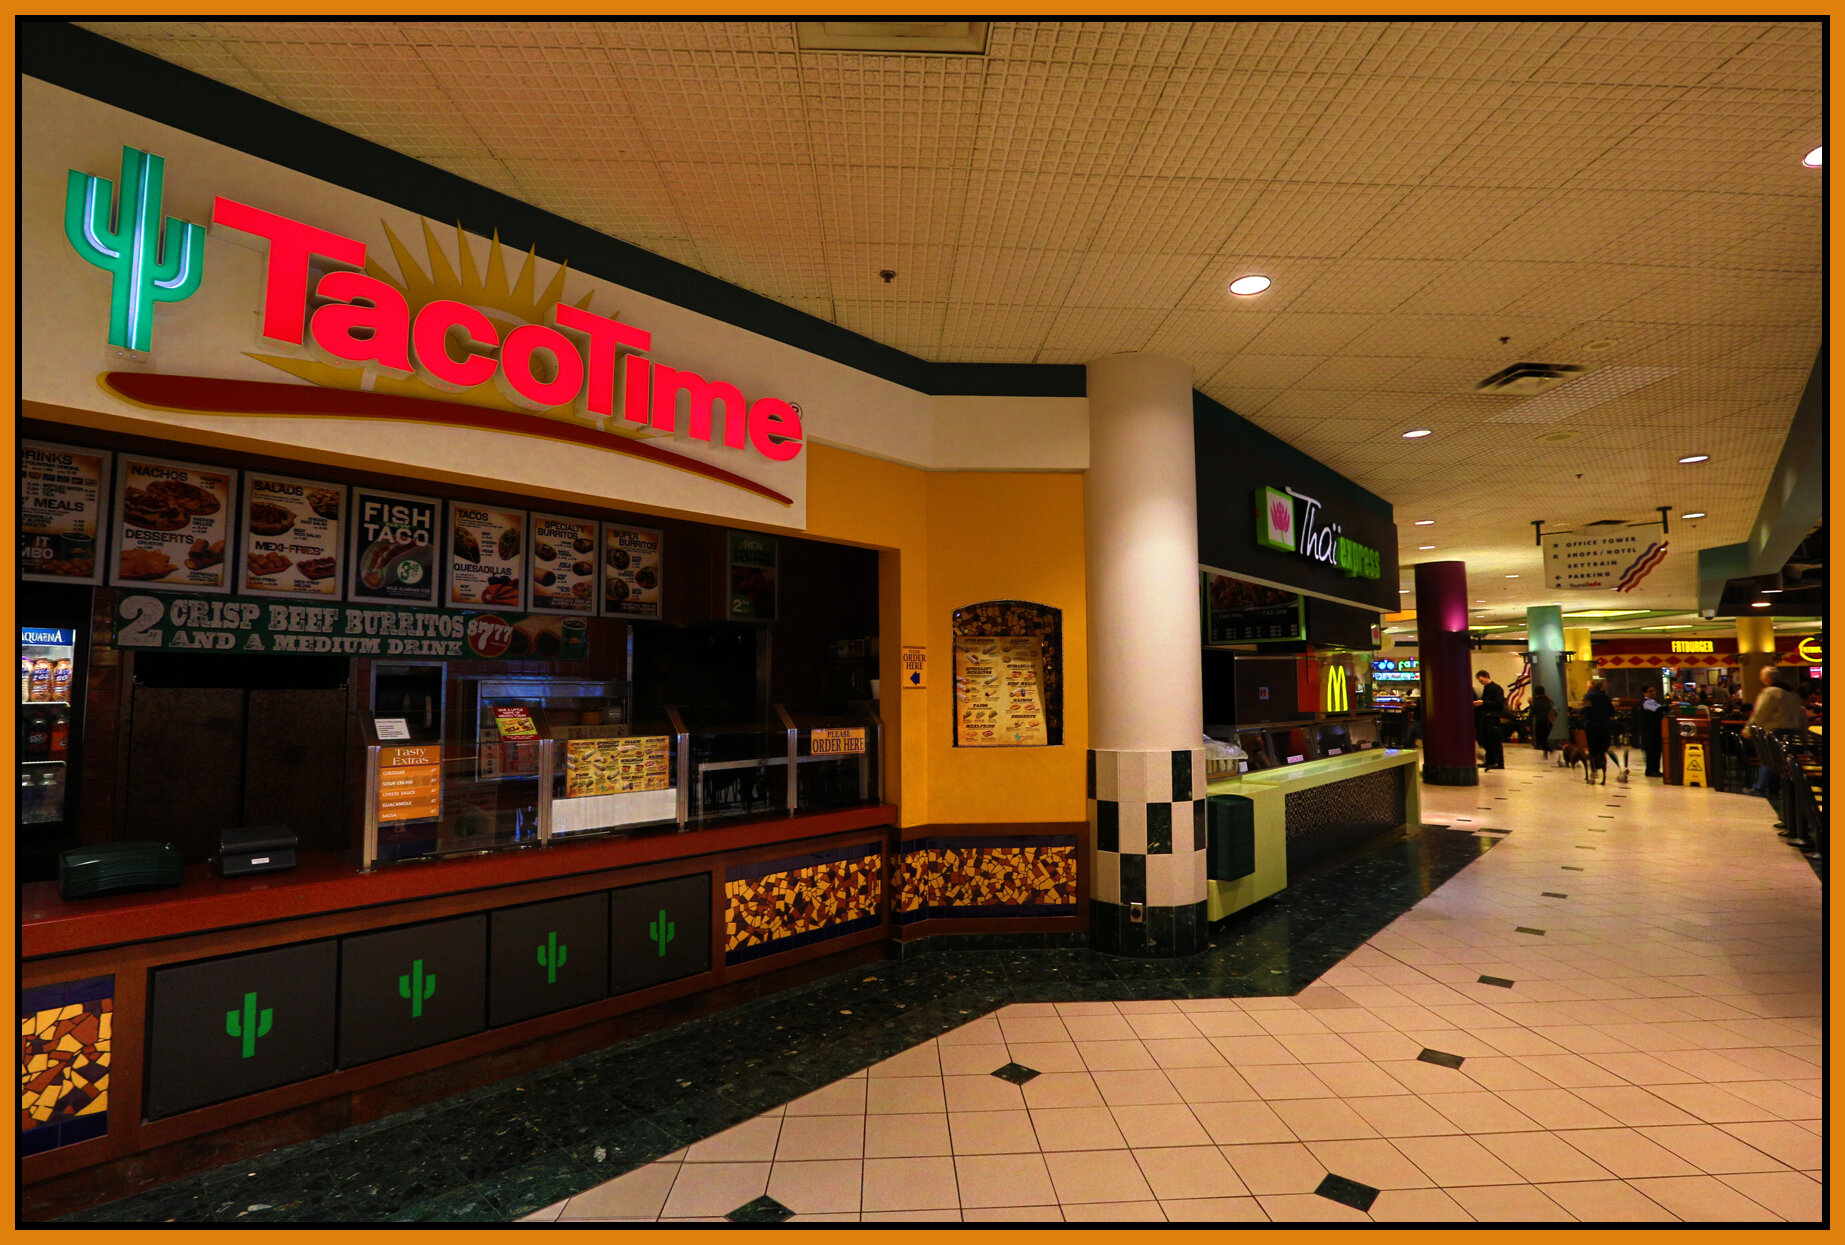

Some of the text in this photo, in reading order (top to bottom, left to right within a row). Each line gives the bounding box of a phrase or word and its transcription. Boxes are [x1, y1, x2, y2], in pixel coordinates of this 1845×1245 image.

[213, 195, 803, 462] TacoTime
[131, 465, 188, 482] NACHOS
[254, 480, 304, 496] SALADS
[34, 498, 84, 511] MEALS
[364, 501, 431, 529] FISH
[458, 509, 489, 522] TACOS
[545, 520, 585, 533] SPECIALTY
[125, 528, 194, 545] DESSERTS
[363, 523, 429, 547] TACO
[538, 527, 578, 540] BURRITOS
[614, 530, 638, 540] SUPER
[619, 538, 657, 550] BURRITOS
[1566, 536, 1636, 548] OFFICE TOWER
[1339, 536, 1380, 578] express
[454, 563, 512, 576] QUESADILLAS
[1568, 560, 1617, 569] SKYTRAIN
[1568, 571, 1610, 579] PARKING
[117, 595, 166, 647] 2
[170, 599, 261, 630] CRISP
[268, 605, 339, 633] BEEF
[345, 609, 465, 639] BURRITOS
[169, 630, 464, 656] AND A MEDIUM DRINK
[1671, 640, 1714, 653] FATBURGER
[903, 654, 926, 662] ORDER
[906, 662, 923, 670] HERE
[812, 738, 864, 752] ORDER HERE
[395, 748, 426, 758] Tasty
[392, 756, 428, 766] Extras
